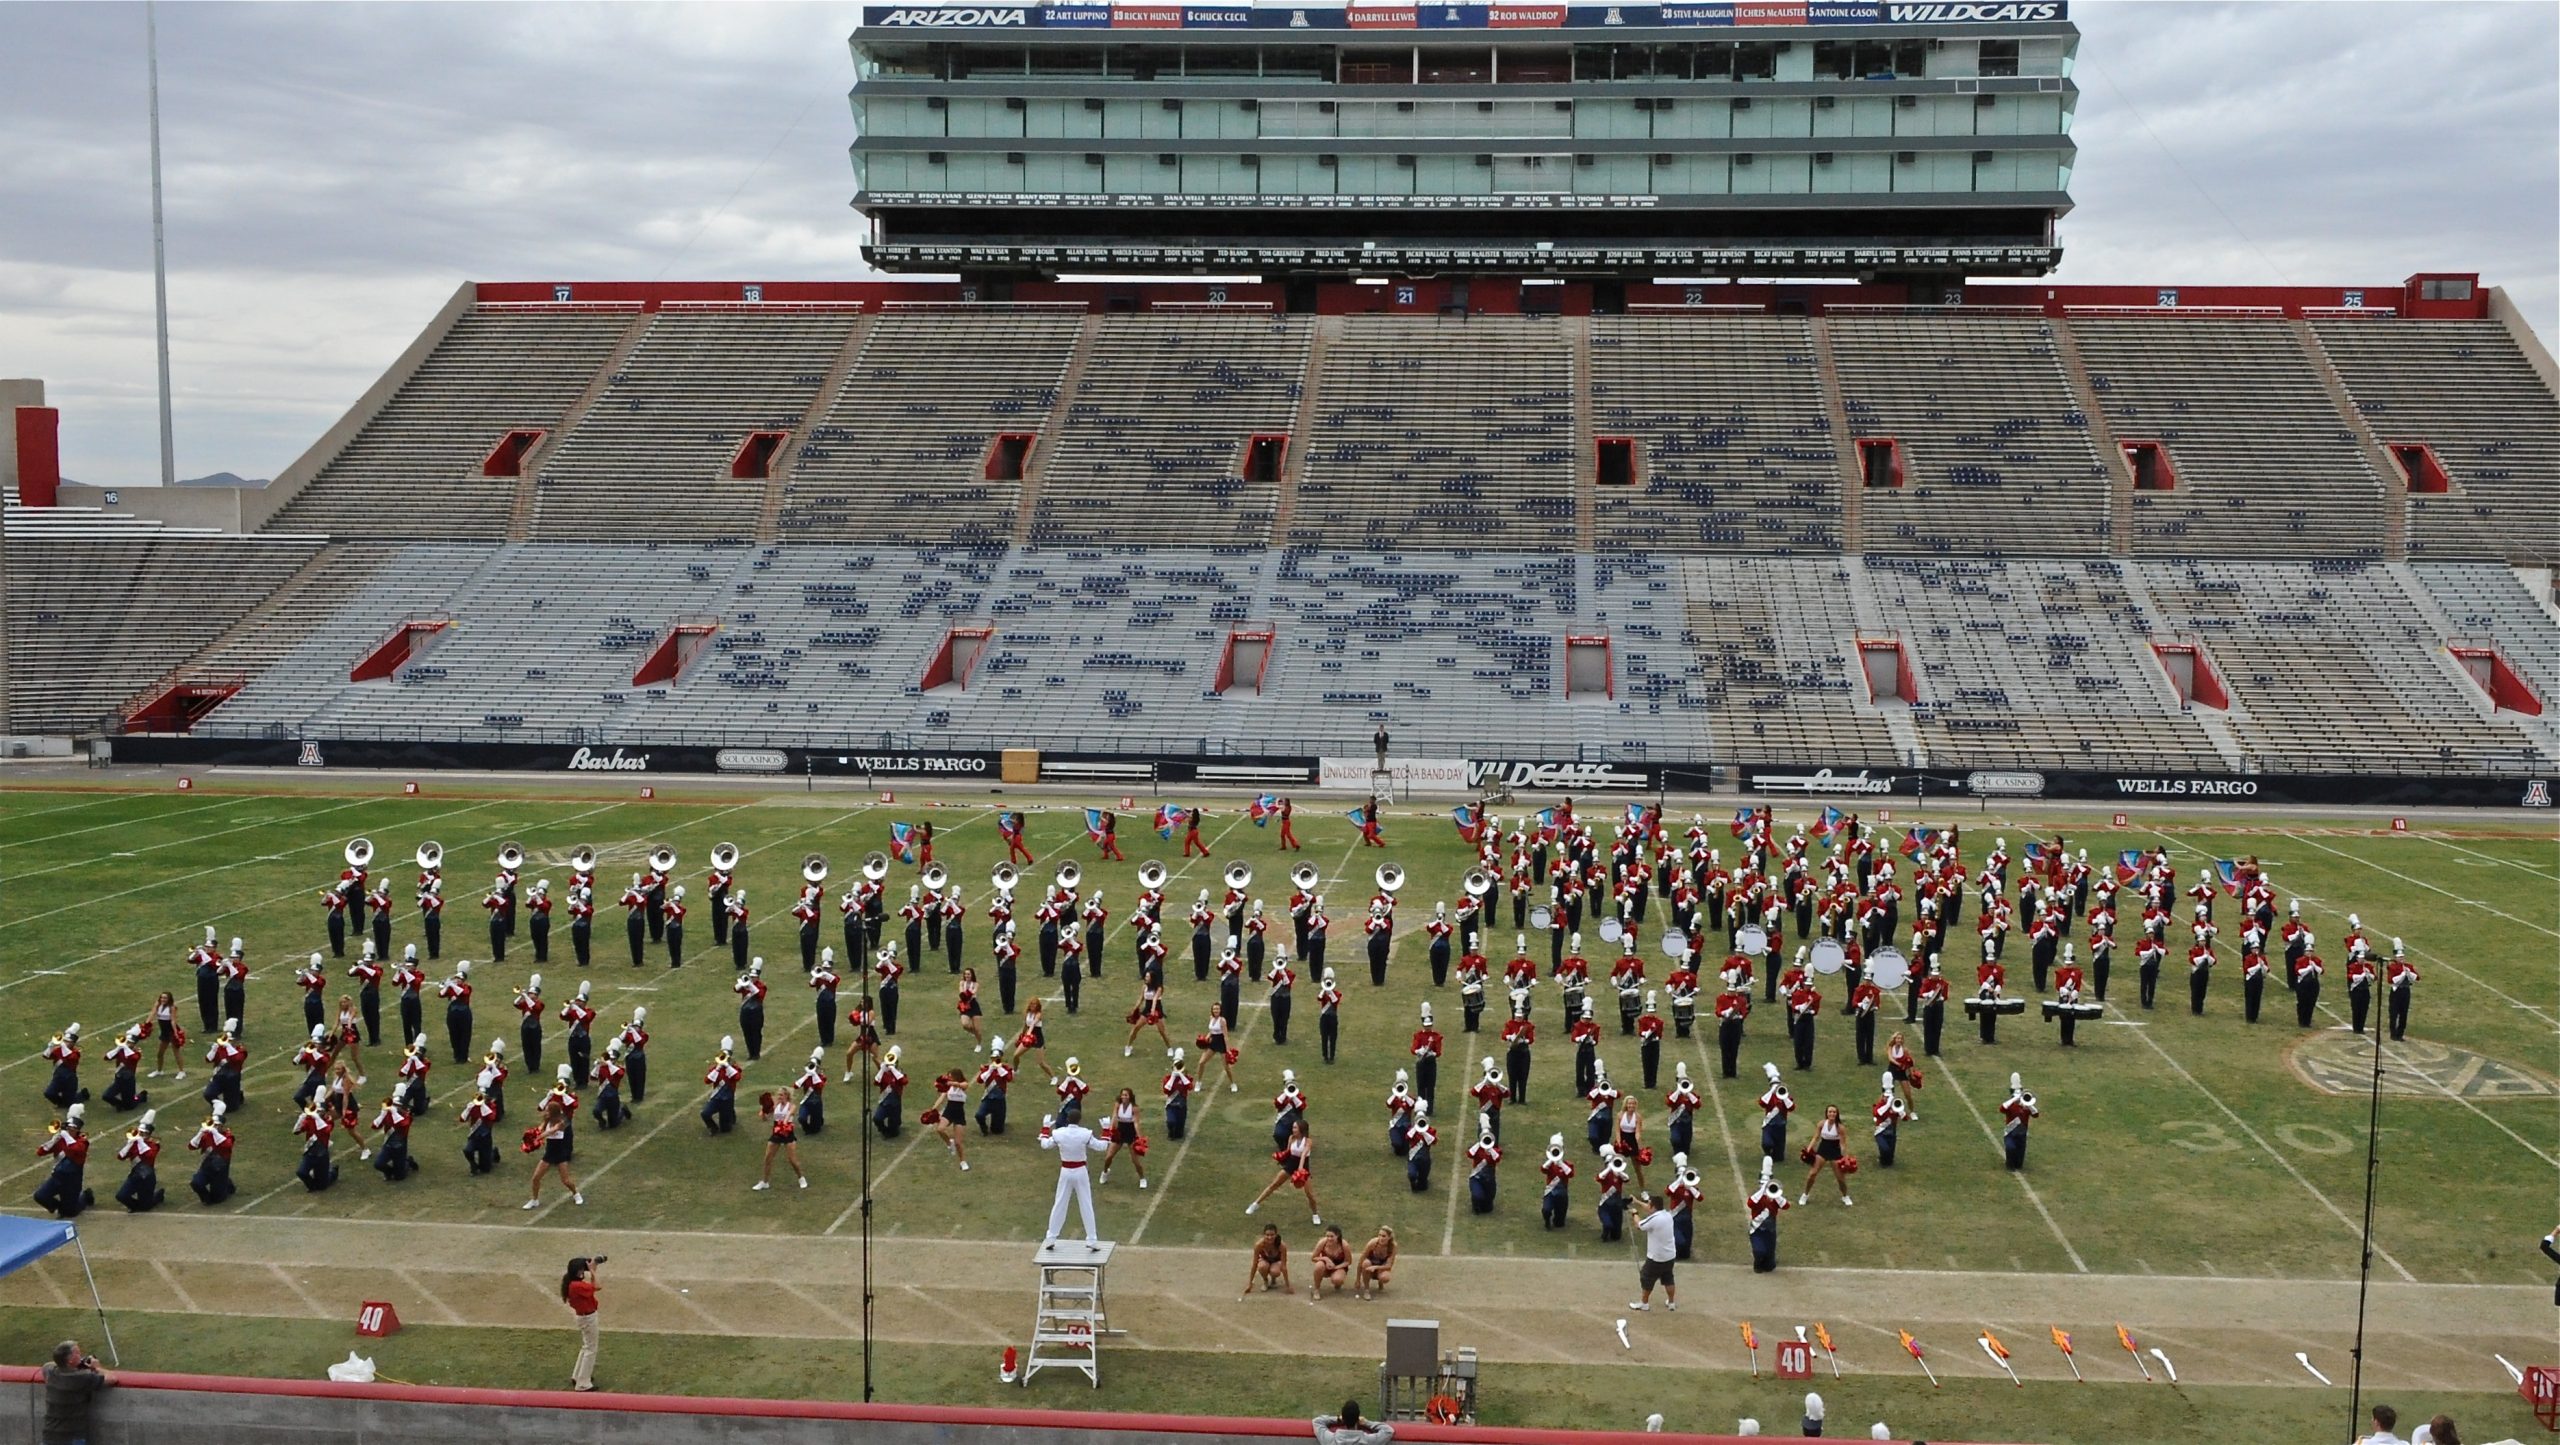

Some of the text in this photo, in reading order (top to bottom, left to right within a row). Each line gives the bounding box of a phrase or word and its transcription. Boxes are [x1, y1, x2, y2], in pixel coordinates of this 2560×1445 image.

[880, 9, 1026, 26] ARIZONA
[1045, 11, 1108, 21] 22 ART LUPPINO
[1124, 11, 1148, 22] RICKY
[1150, 11, 1180, 22] HUNLEY
[1187, 11, 1247, 22] 6 CHUCK CECIL
[1347, 12, 1416, 22] 4 DARRYLL LEWIS
[1489, 11, 1559, 21] 92 ROB WALDROP
[1673, 8, 1691, 19] STEVE
[1693, 8, 1734, 19] McLAUGHLIN
[1735, 8, 1807, 18] 11 CHRIS McALISTER
[1809, 7, 1878, 17] 5 ANTOINE CASON
[1890, 3, 2058, 22] WILDCATS
[556, 291, 569, 302] 17
[745, 291, 760, 302] 18
[963, 291, 977, 302] 19
[1209, 291, 1226, 303] 20
[1398, 292, 1413, 303] 21
[1686, 293, 1702, 305] 22
[1945, 294, 1962, 305] 23
[2159, 295, 2177, 307] 24
[2344, 296, 2362, 308] 25
[104, 491, 118, 503] 16
[568, 747, 650, 771] Bashas'
[723, 754, 781, 766] SOL CASINOS
[855, 757, 986, 773] WELLS FARGO
[1323, 767, 1368, 779] UNIVERSITY
[1421, 769, 1445, 780] BAND
[1447, 769, 1463, 780] DAY
[1975, 777, 2038, 788] SOL CASINOS
[2116, 779, 2258, 795] WELLS FARGO
[1880, 811, 1889, 820] 30
[2116, 816, 2125, 824] 20
[2395, 819, 2405, 829] 10
[360, 1306, 384, 1332] 40
[1781, 1347, 1806, 1373] 40
